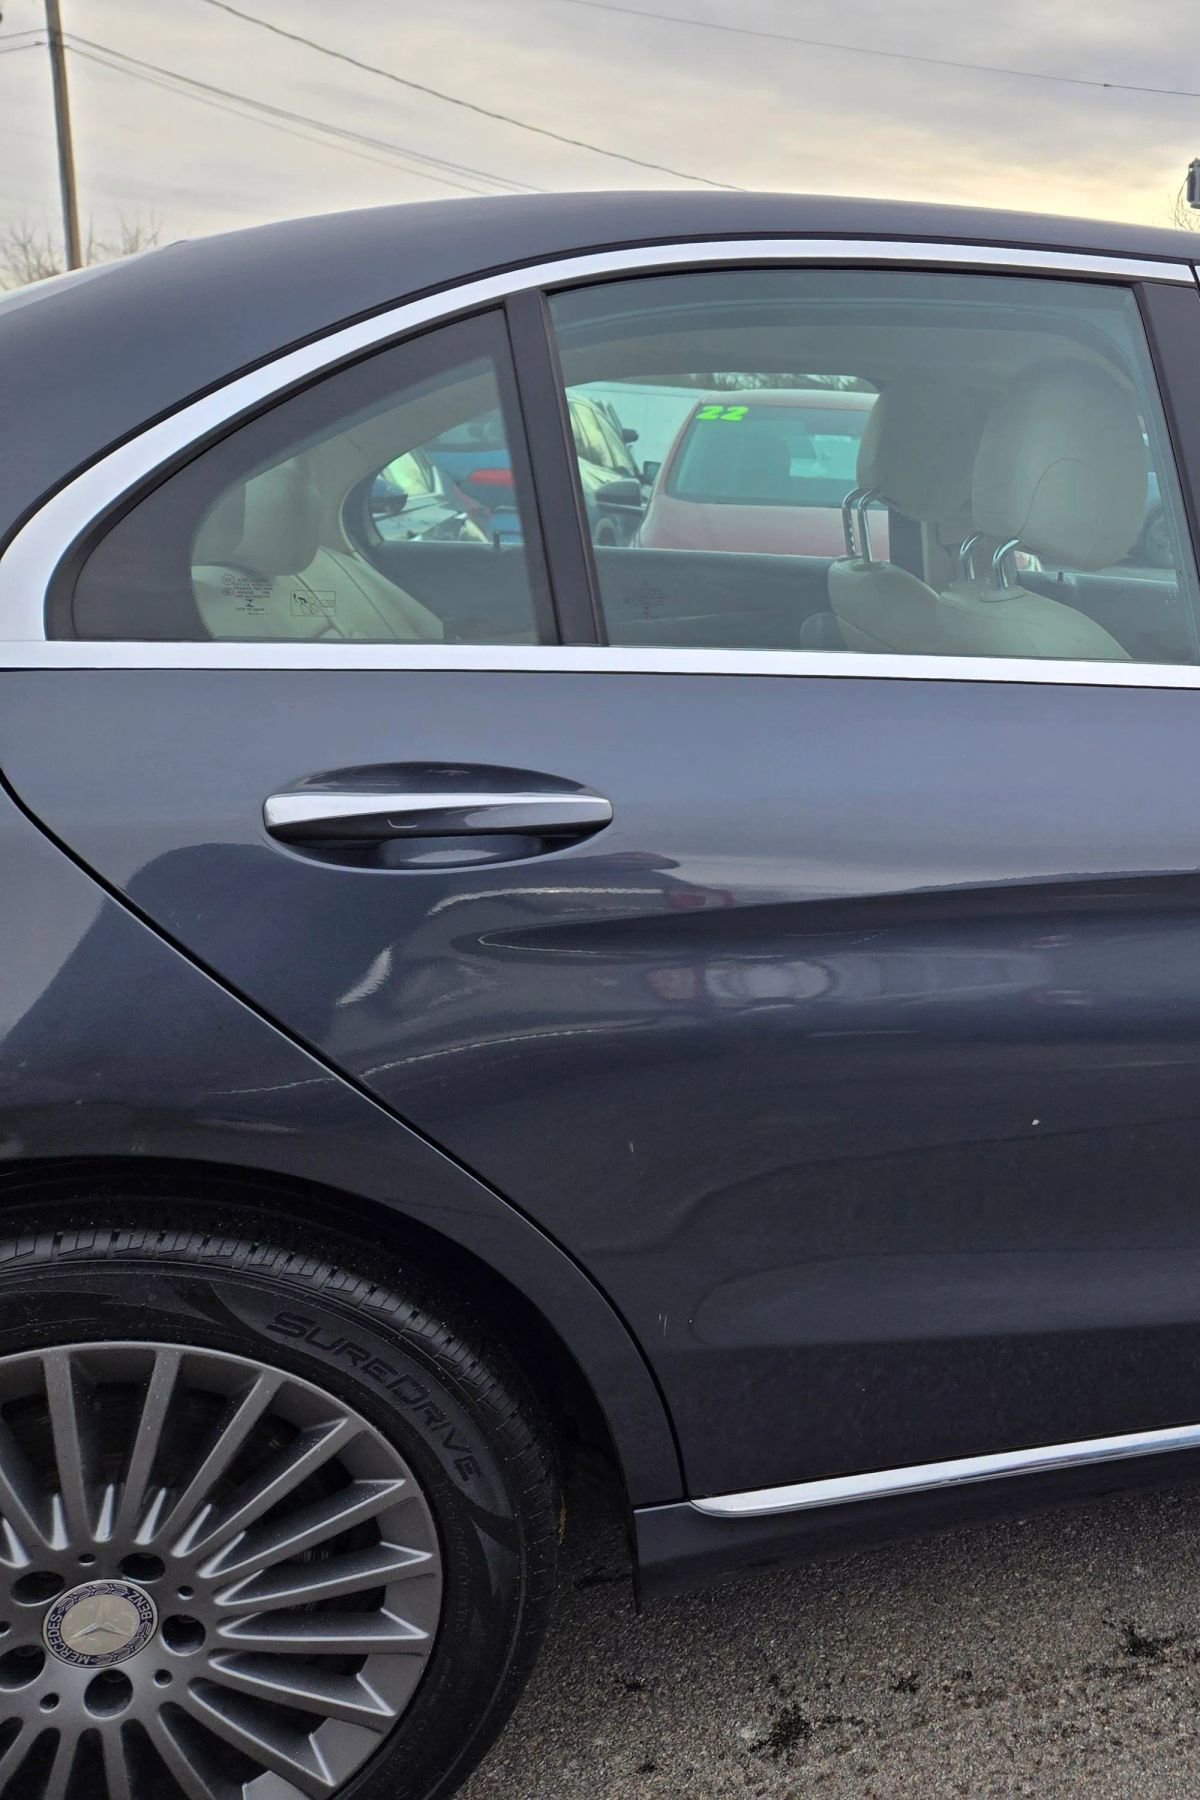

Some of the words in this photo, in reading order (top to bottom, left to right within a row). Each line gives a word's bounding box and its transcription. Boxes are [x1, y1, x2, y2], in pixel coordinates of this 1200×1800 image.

[696, 405, 748, 421] 22
[265, 1311, 484, 1482] SUREDRIVE
[127, 1590, 153, 1620] BENZ
[47, 1613, 92, 1665] MERCEDES
